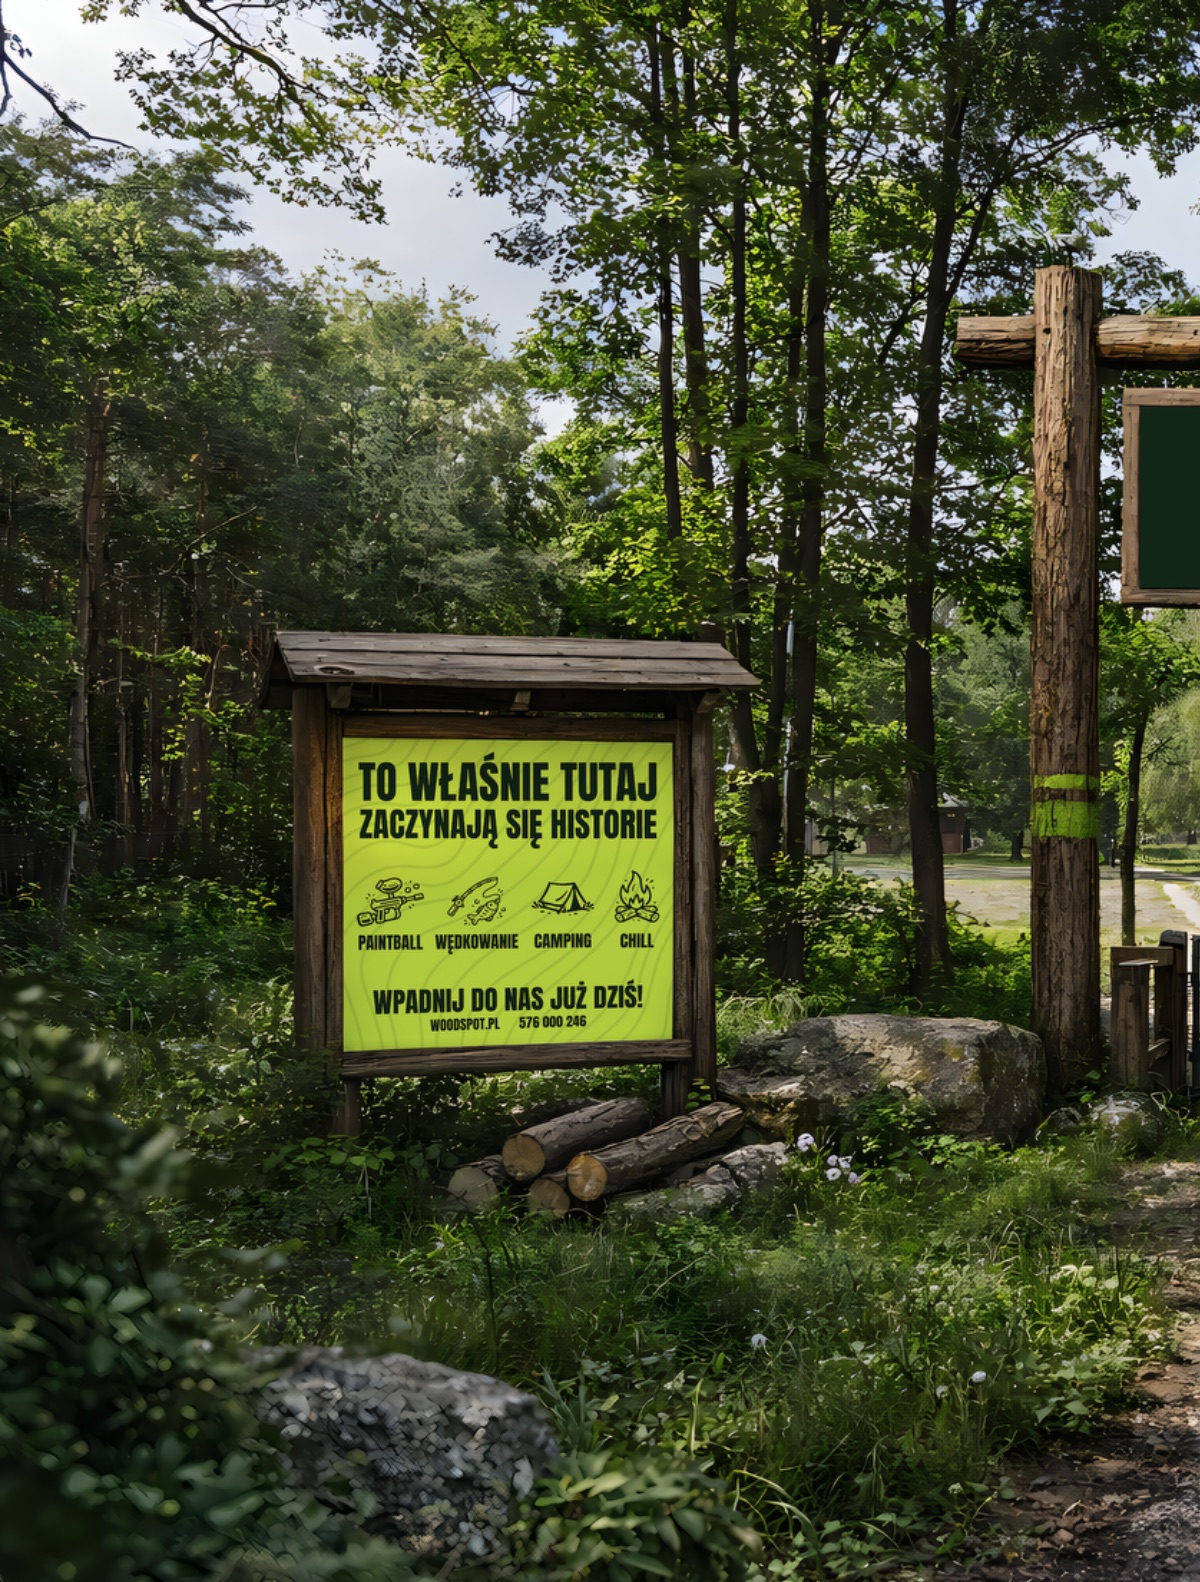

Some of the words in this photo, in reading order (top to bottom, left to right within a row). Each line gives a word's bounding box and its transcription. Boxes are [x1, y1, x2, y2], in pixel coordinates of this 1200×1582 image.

[358, 762, 396, 801] TO
[408, 752, 549, 801] WŁAŚNIE
[560, 762, 657, 801] TUTAJ
[359, 809, 498, 849] ZACZYNAJĄ
[506, 809, 542, 849] SIĘ
[551, 809, 657, 839] HISTORIE
[358, 934, 423, 951] PAINTBALL
[435, 934, 519, 955] WĘDKOWANIE
[534, 933, 592, 949] CAMPING
[620, 933, 654, 948] CHILL
[373, 988, 465, 1015] WPADNIJ
[471, 987, 498, 1012] DO
[505, 986, 544, 1012] NAS
[550, 981, 587, 1010] JUŻ
[594, 979, 643, 1008] DZIŚ!
[430, 1017, 500, 1032] WOODSPOT.PL
[519, 1016, 540, 1029] 576
[542, 1015, 563, 1029] 000
[566, 1015, 587, 1028] 246
